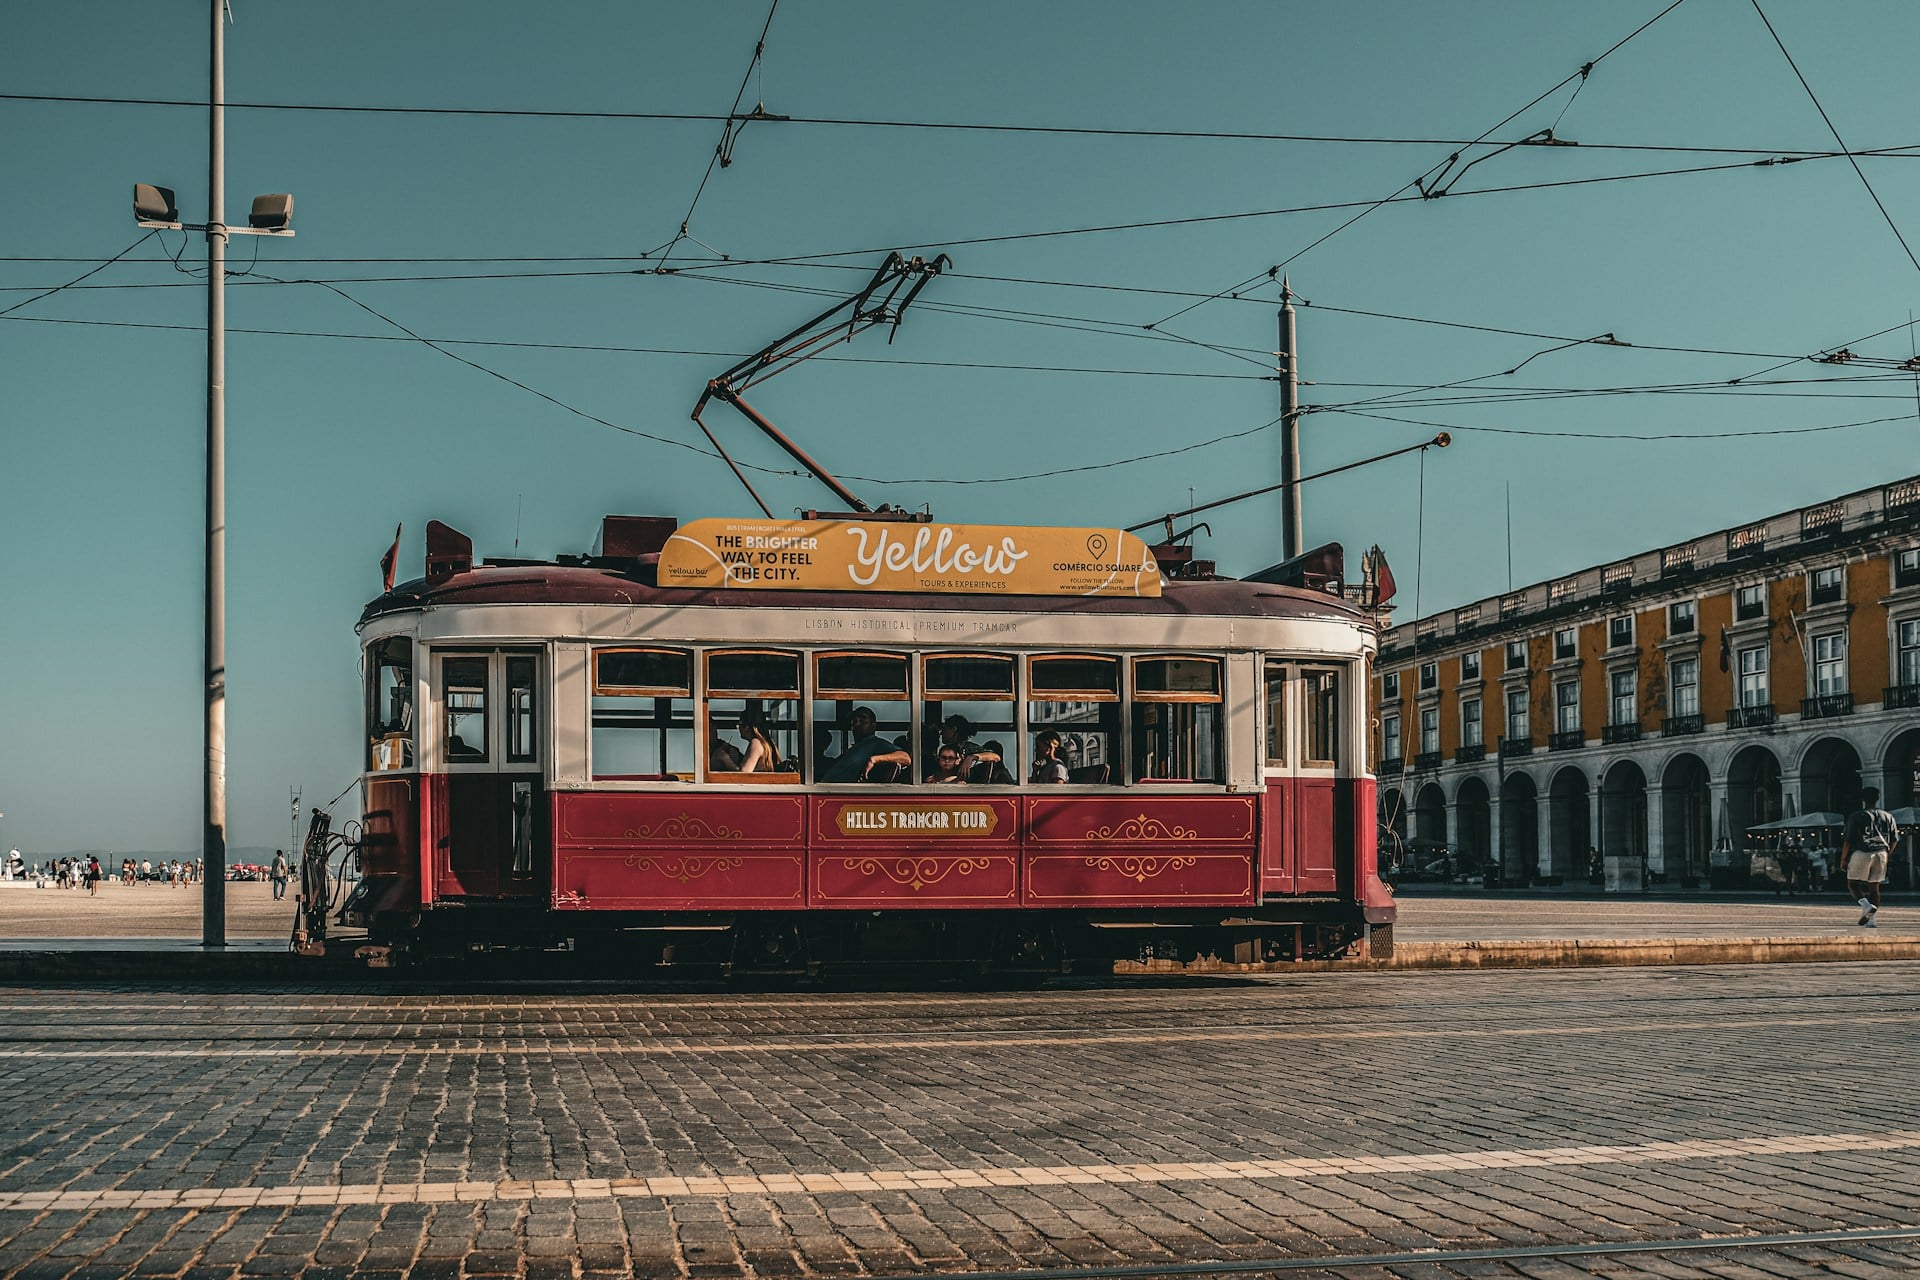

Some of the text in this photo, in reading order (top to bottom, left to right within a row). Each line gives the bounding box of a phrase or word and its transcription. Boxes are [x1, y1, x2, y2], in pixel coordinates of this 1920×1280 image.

[715, 535, 818, 550] THE BRIGHTER
[721, 551, 812, 565] WAY TO FEEL
[733, 567, 800, 581] THE CITY.
[1052, 562, 1142, 572] COMÉRCIO SQUARE
[920, 579, 1007, 589] TOURS & EXPERIENCES
[805, 619, 1018, 633] LISBON HISTORICAL PREMIUM TRAMCAR
[846, 811, 988, 829] HILLS TRAMCAR TOUR
